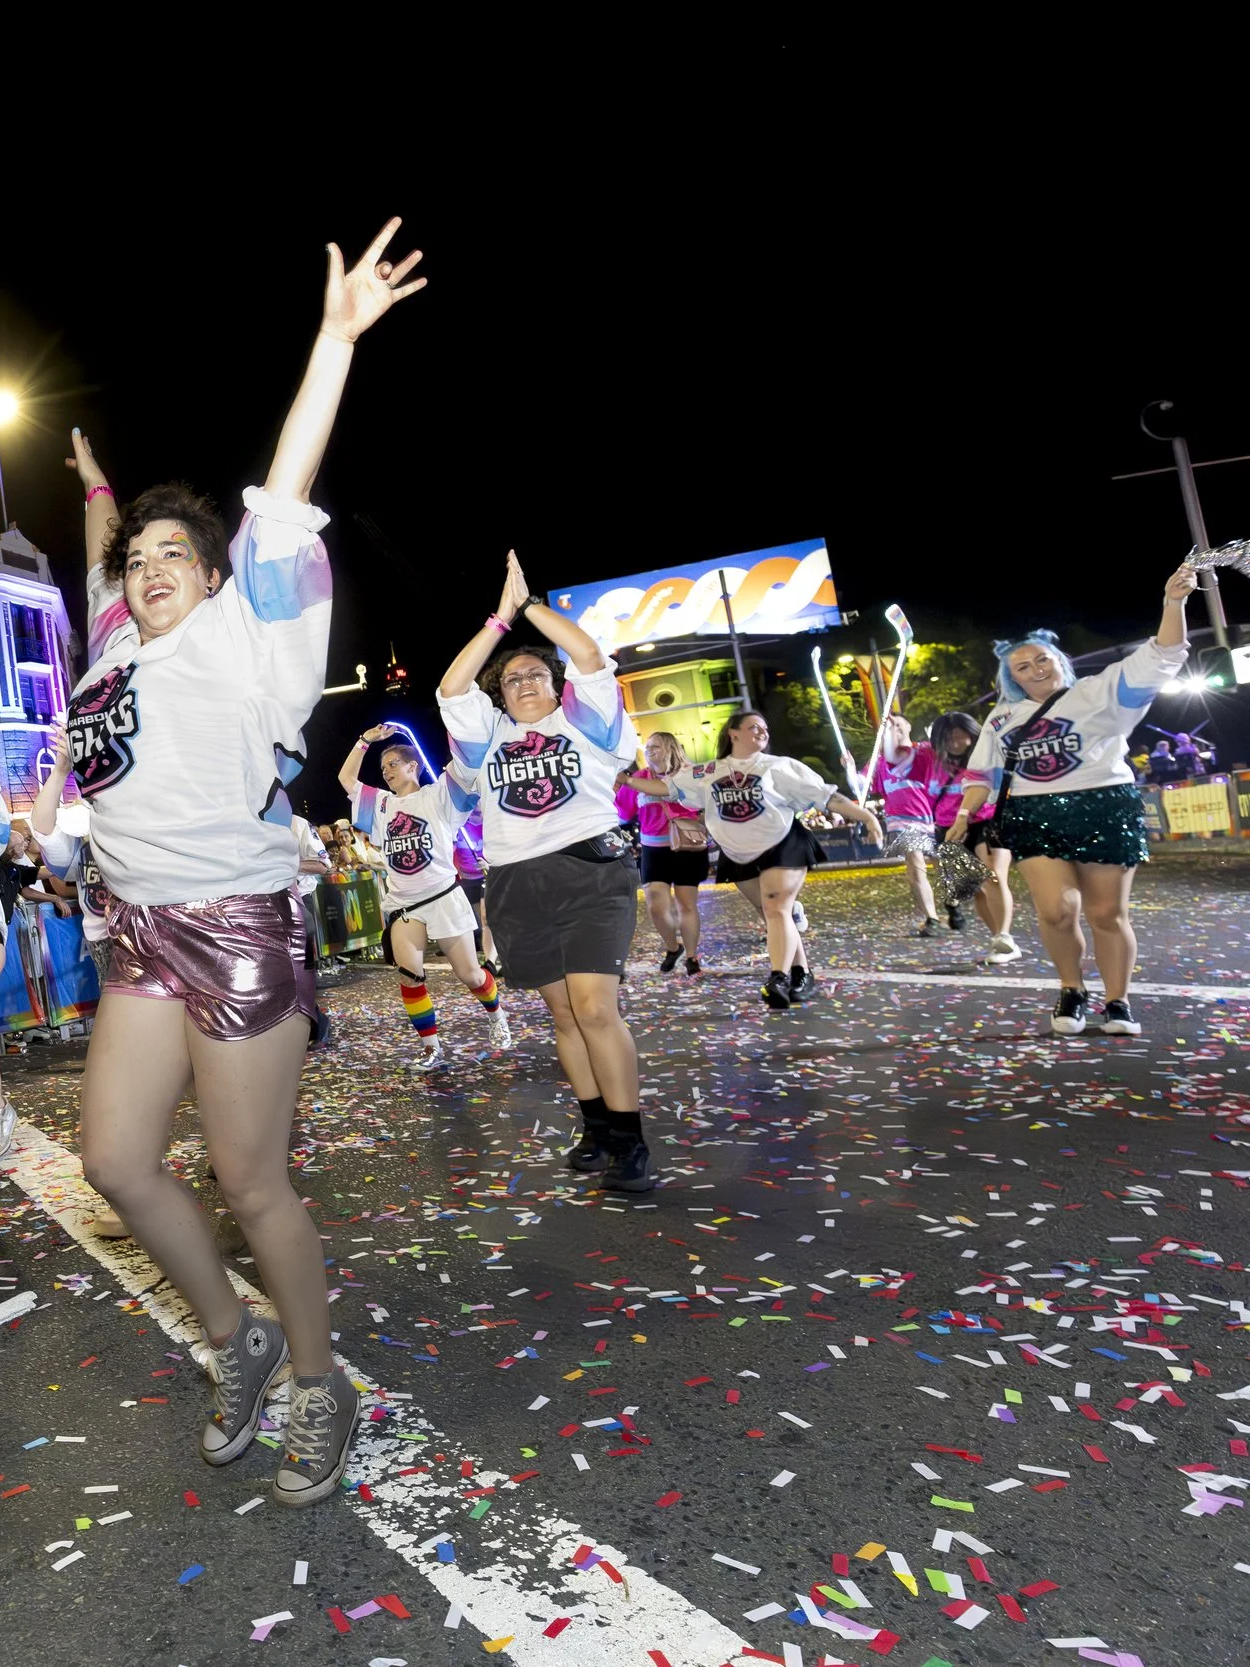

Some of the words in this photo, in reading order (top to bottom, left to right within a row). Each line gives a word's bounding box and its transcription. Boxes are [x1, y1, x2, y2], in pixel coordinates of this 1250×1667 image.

[510, 750, 555, 763] HARBOUR
[489, 752, 580, 789] LIGHTS
[383, 834, 433, 856] LIGHTS
